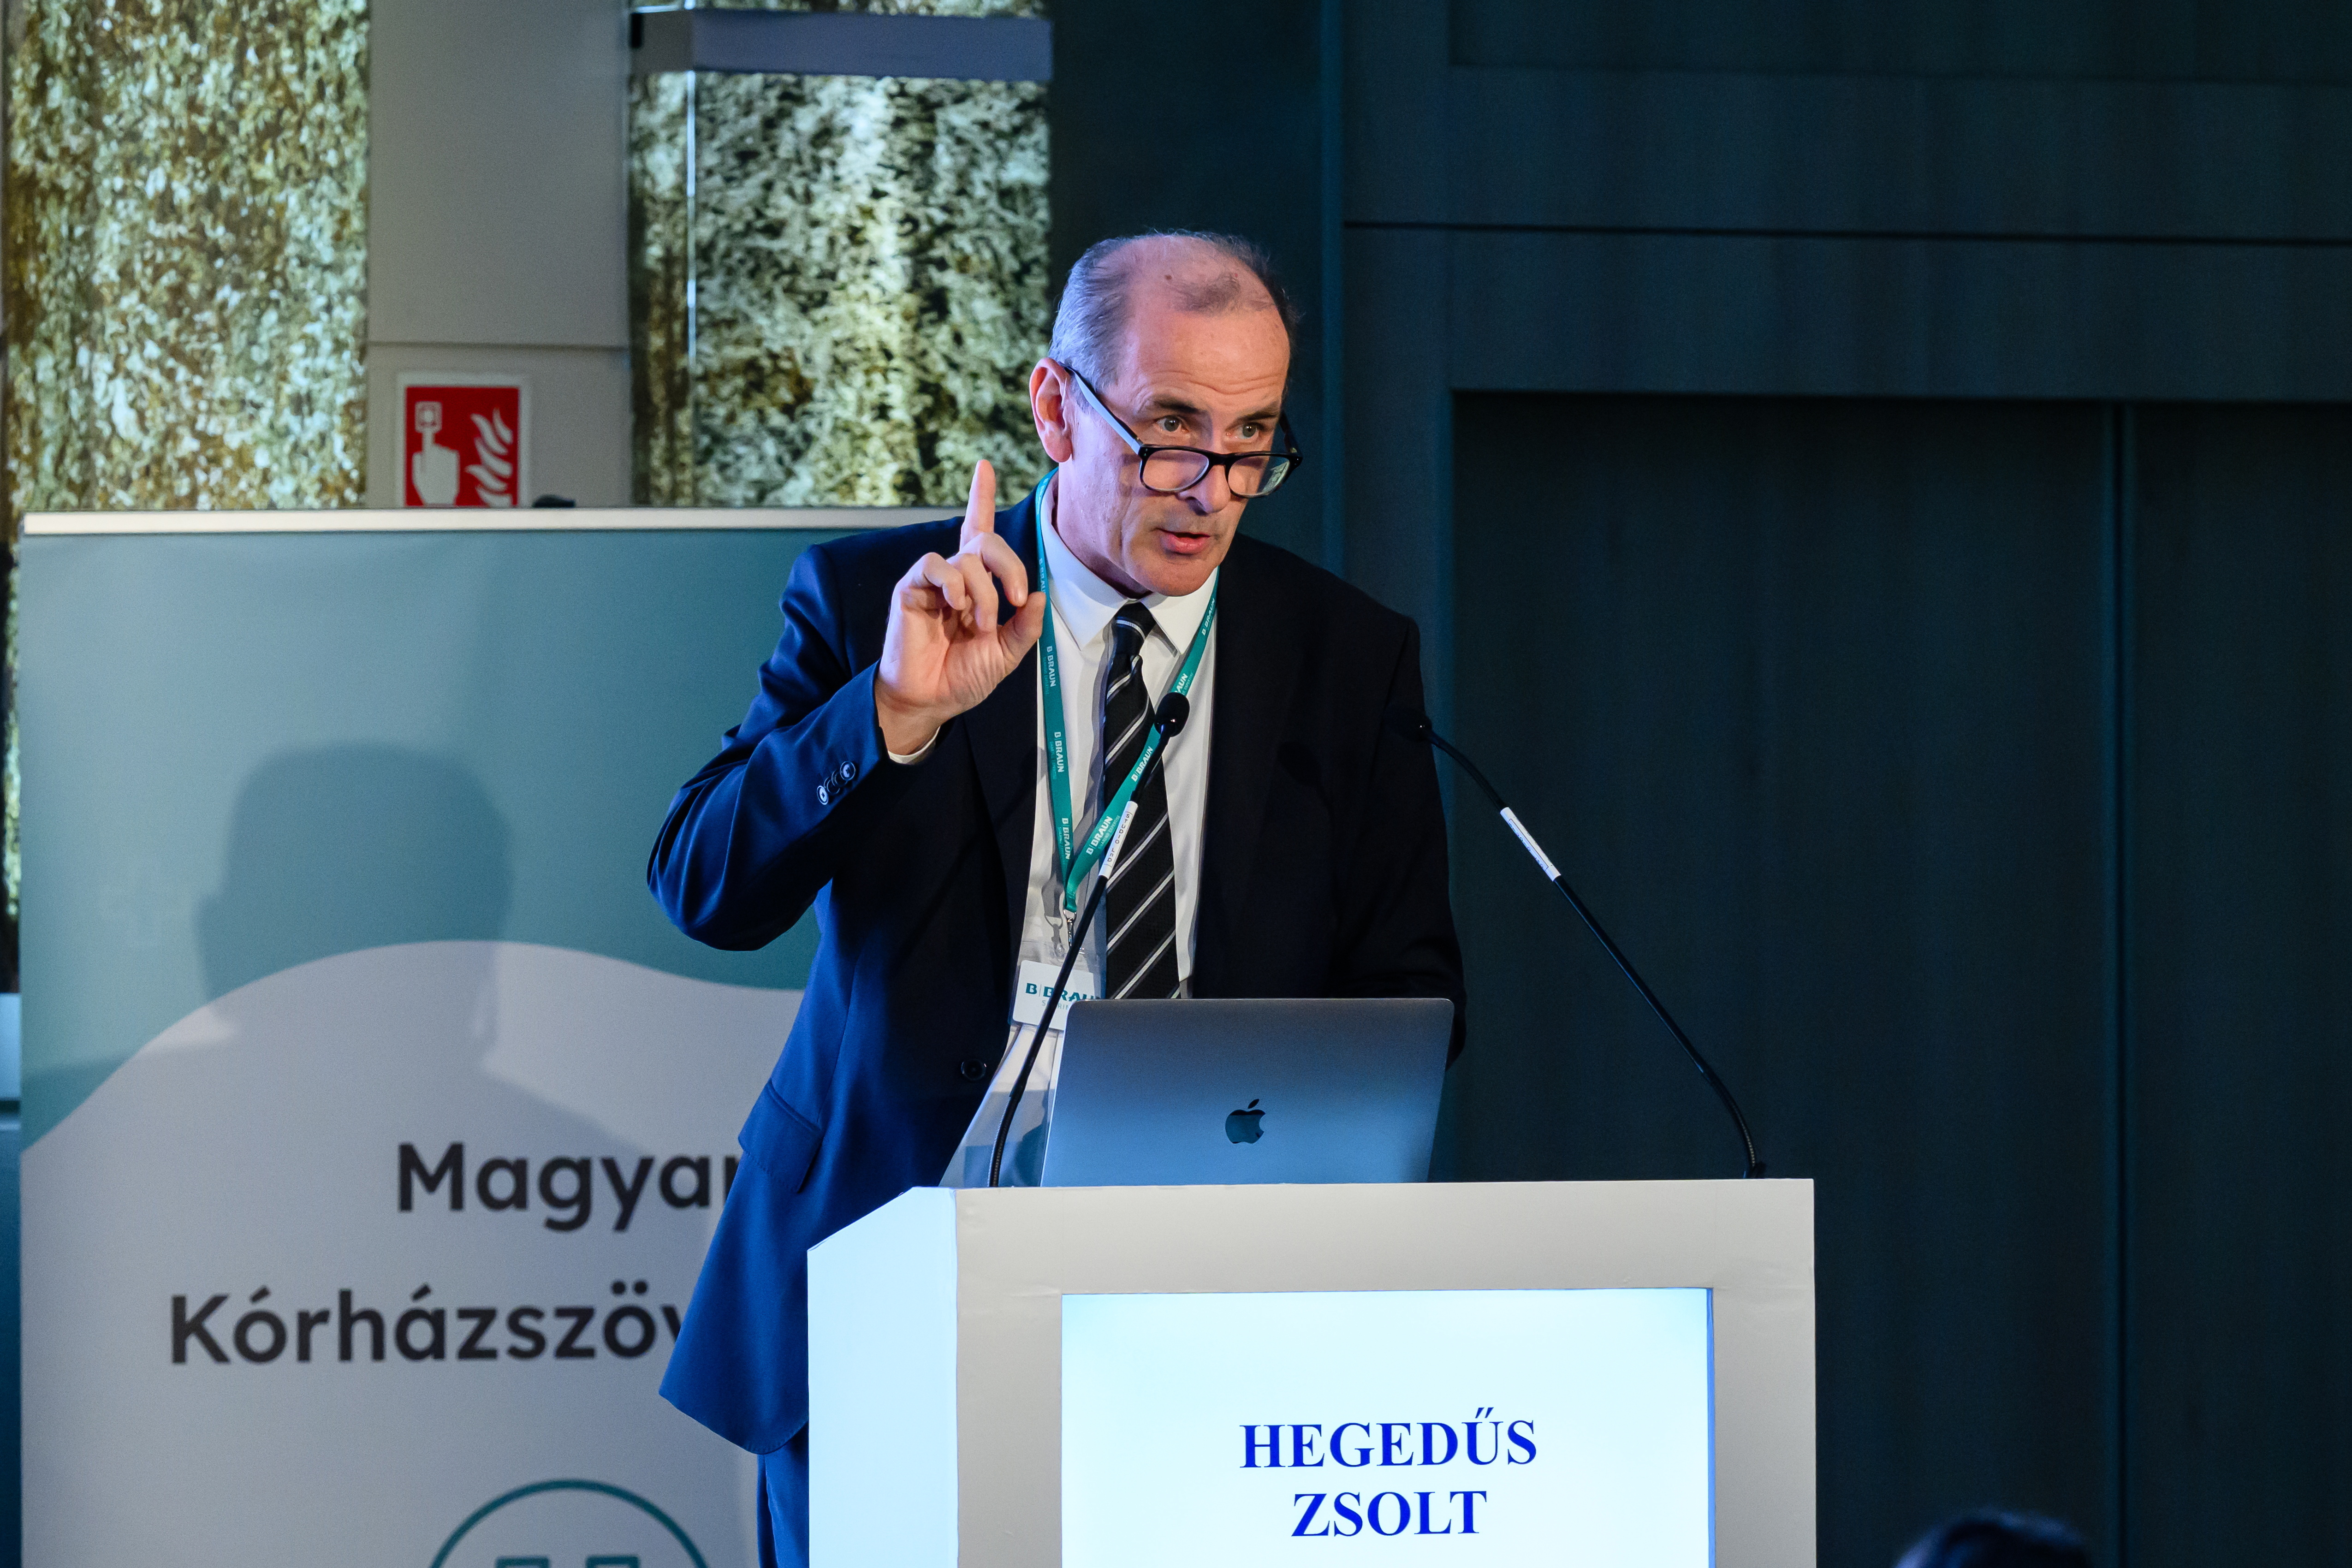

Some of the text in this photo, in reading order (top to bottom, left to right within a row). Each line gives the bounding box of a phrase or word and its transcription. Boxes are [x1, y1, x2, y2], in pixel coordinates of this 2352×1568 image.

[1205, 598, 1215, 628] BRAUN
[1047, 655, 1056, 687] BRAUN
[1055, 740, 1064, 772] BRAUN
[1131, 746, 1153, 782] B BRAUN
[1090, 816, 1113, 847] BRAUN
[1115, 814, 1130, 844] STUDIO
[1026, 983, 1037, 994] B
[1239, 1407, 1537, 1468] HEGEDŰS
[1291, 1490, 1487, 1537] ZSOLT
